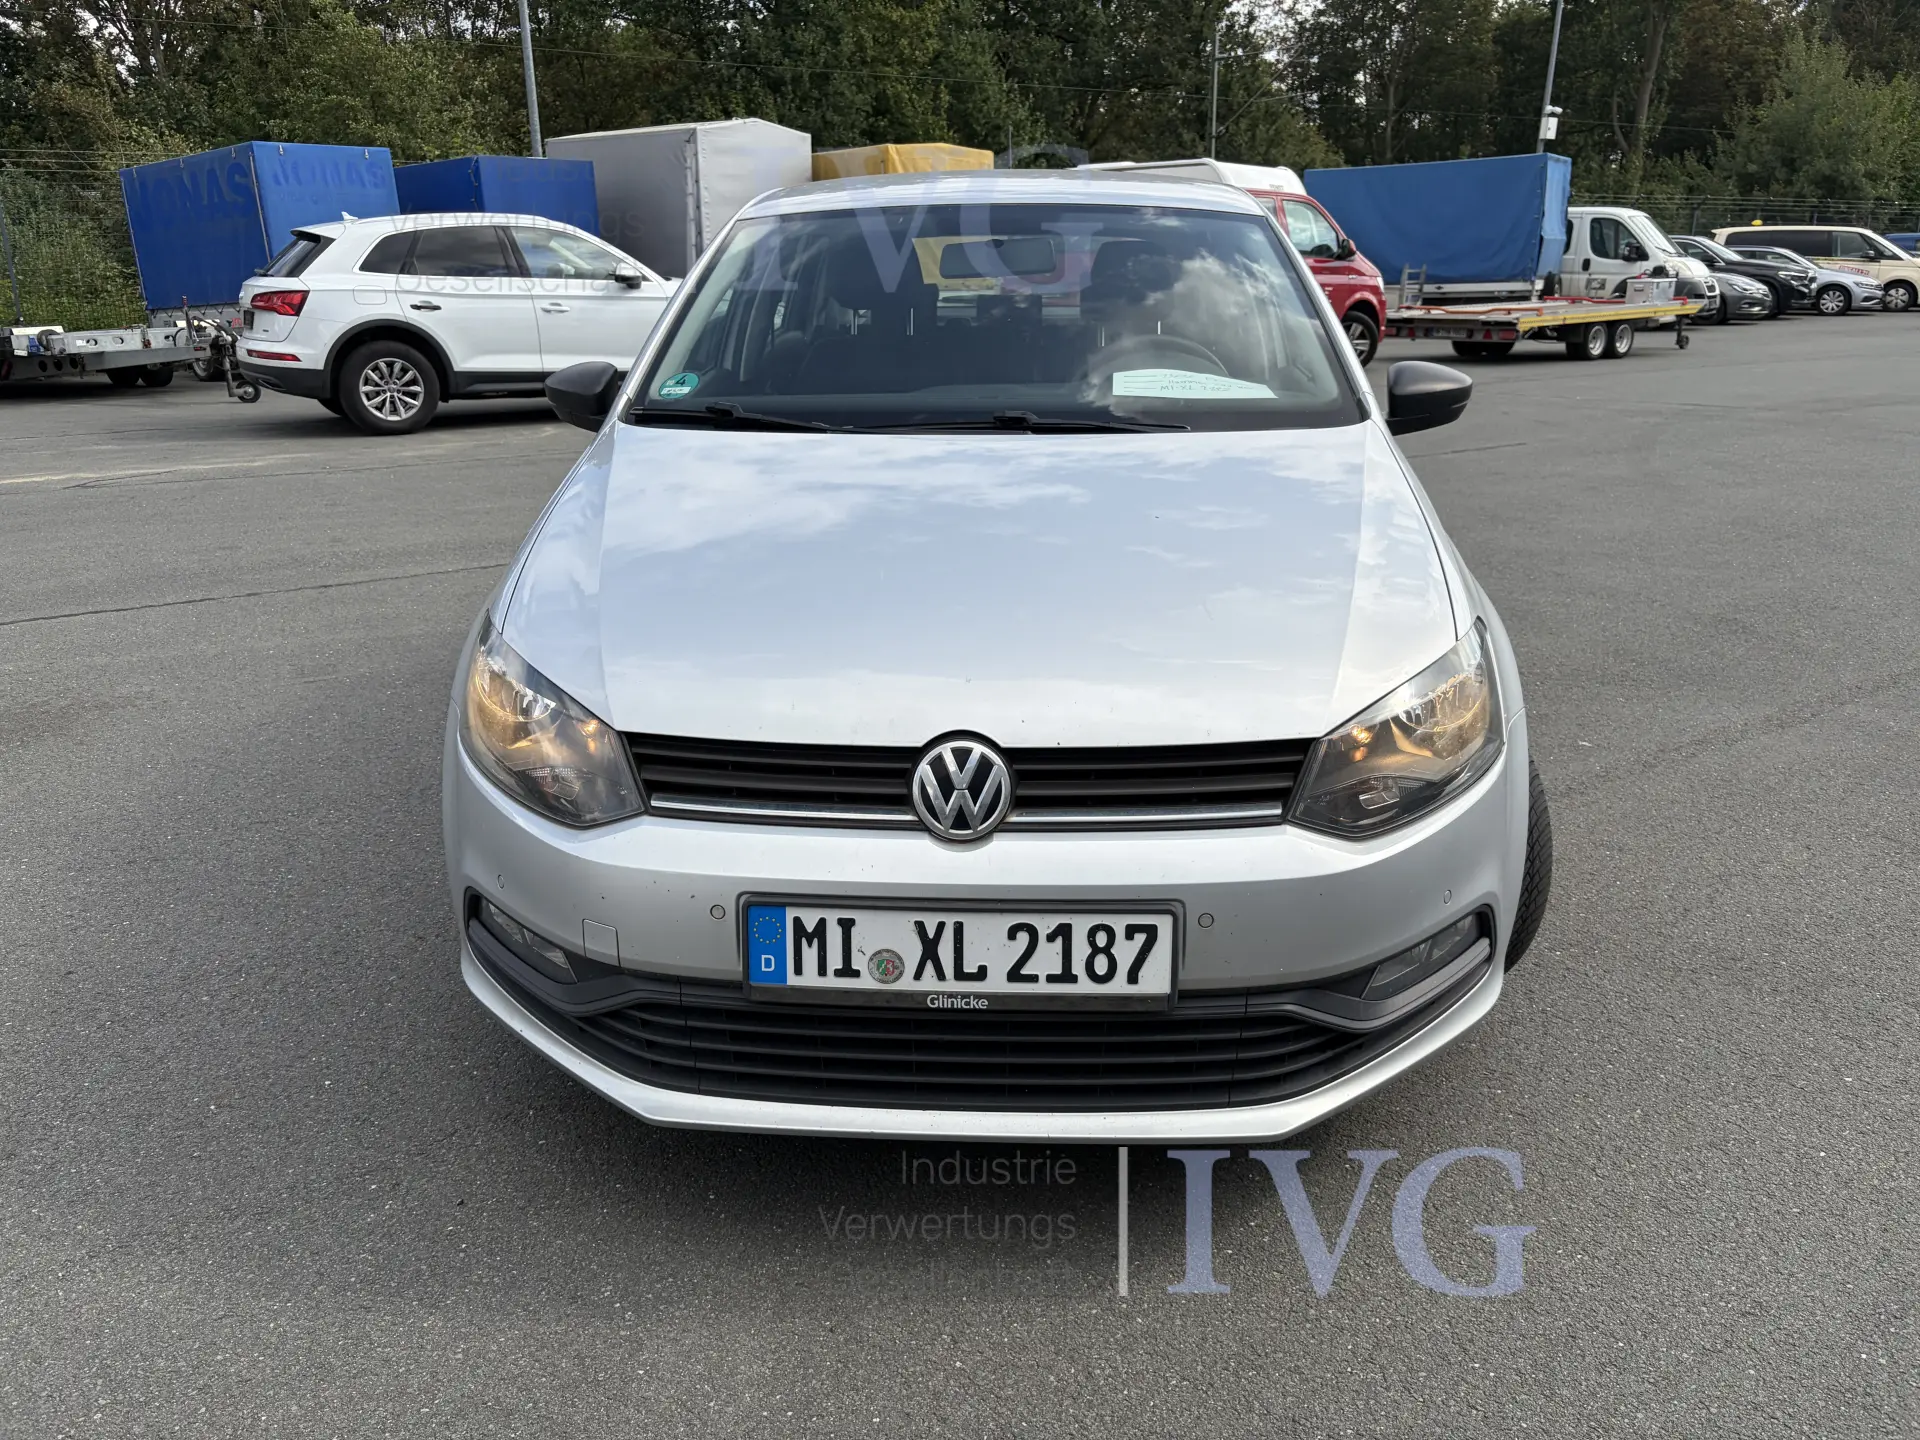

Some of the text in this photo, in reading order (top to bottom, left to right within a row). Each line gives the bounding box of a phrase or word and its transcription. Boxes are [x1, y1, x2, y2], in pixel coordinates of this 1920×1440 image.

[792, 916, 1159, 984] MI XL 2187
[761, 954, 776, 972] D
[926, 993, 989, 1010] Glinicke
